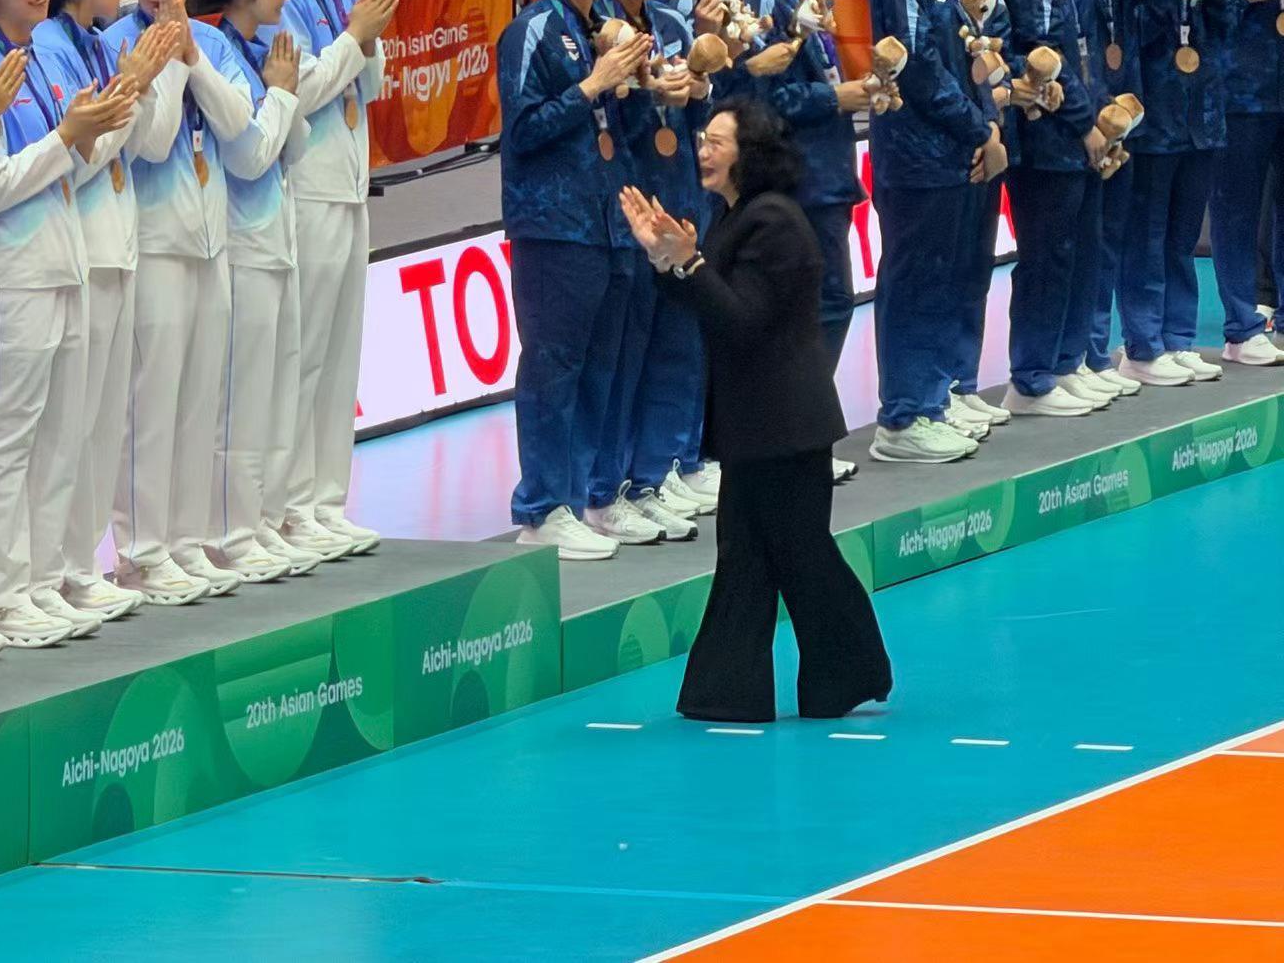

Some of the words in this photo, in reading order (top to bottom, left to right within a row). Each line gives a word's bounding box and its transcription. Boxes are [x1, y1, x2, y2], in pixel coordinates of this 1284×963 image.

[1172, 436, 1233, 471] Aichi-Nagoya
[1234, 426, 1258, 453] 2026
[1038, 488, 1063, 514] 20th
[1064, 480, 1092, 507] Asian
[1093, 468, 1129, 496] Games
[899, 520, 966, 557] Aichi-Nagoya
[967, 510, 992, 537] 2026
[422, 633, 502, 675] Aichi-Nagoya
[504, 619, 533, 649] 2026
[245, 697, 276, 728] 20th
[279, 688, 315, 722] Asian
[317, 675, 363, 709] Games
[62, 744, 150, 787] Aichi-Nagoya
[152, 728, 184, 760] 2026
